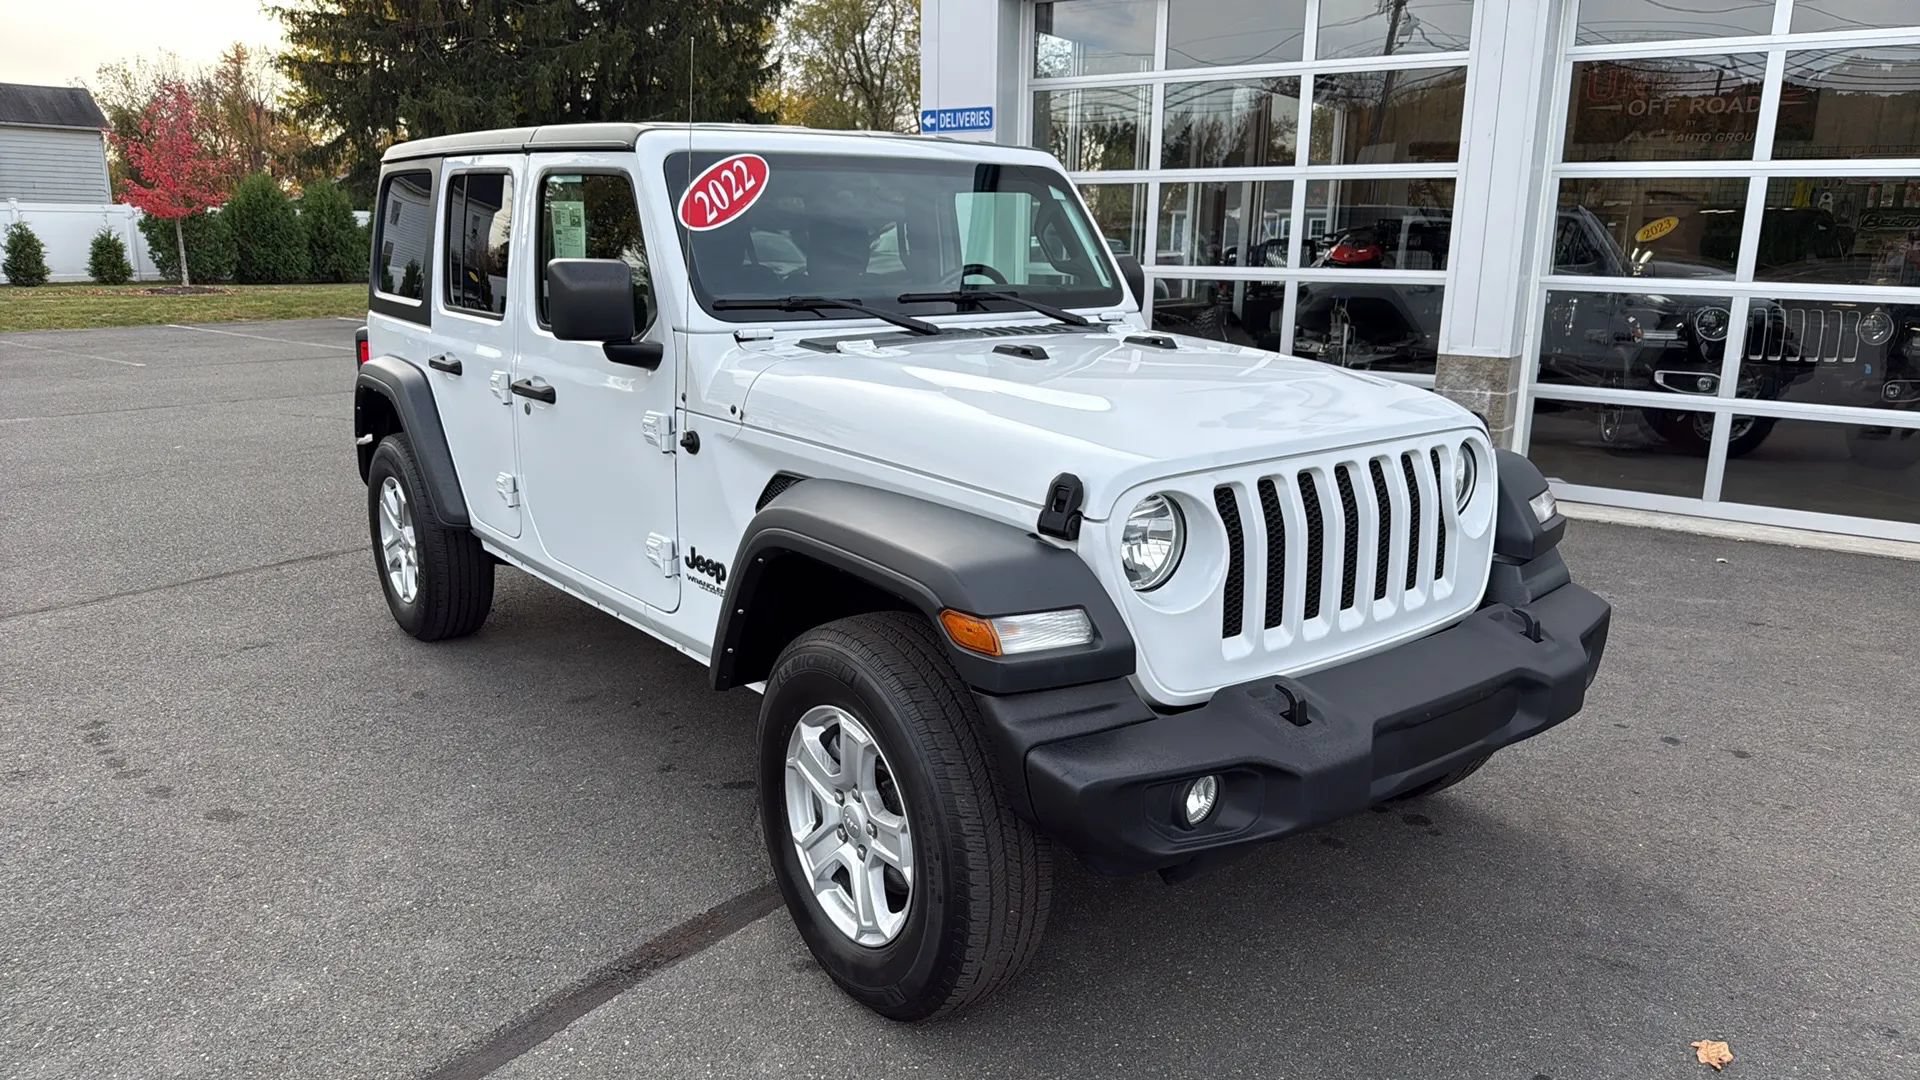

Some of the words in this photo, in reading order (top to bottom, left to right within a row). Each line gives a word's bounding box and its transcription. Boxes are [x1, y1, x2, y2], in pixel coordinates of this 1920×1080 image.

[1628, 98, 1677, 116] OFF
[1689, 95, 1761, 115] ROAD
[939, 110, 991, 129] DELIVERIES
[1715, 131, 1755, 142] GROU
[694, 159, 756, 224] 2022
[1643, 218, 1672, 239] 2023
[684, 545, 727, 585] Jeep
